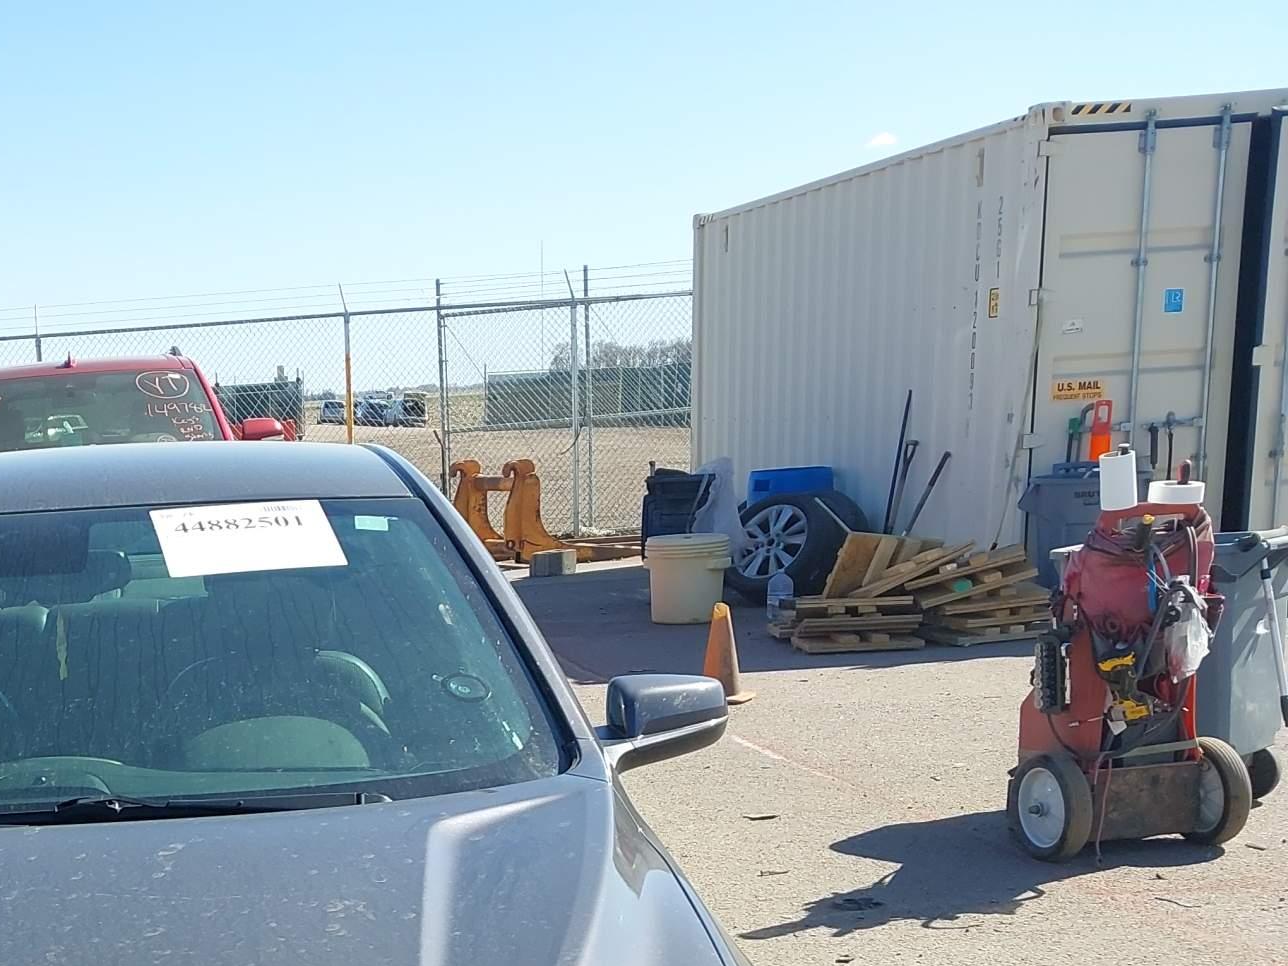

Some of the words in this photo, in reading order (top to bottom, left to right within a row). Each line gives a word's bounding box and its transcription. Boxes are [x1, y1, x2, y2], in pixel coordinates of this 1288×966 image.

[1057, 382, 1076, 392] U.S.
[1078, 381, 1101, 390] MAIL
[1073, 490, 1101, 498] BRUT
[174, 515, 304, 533] 44882501
